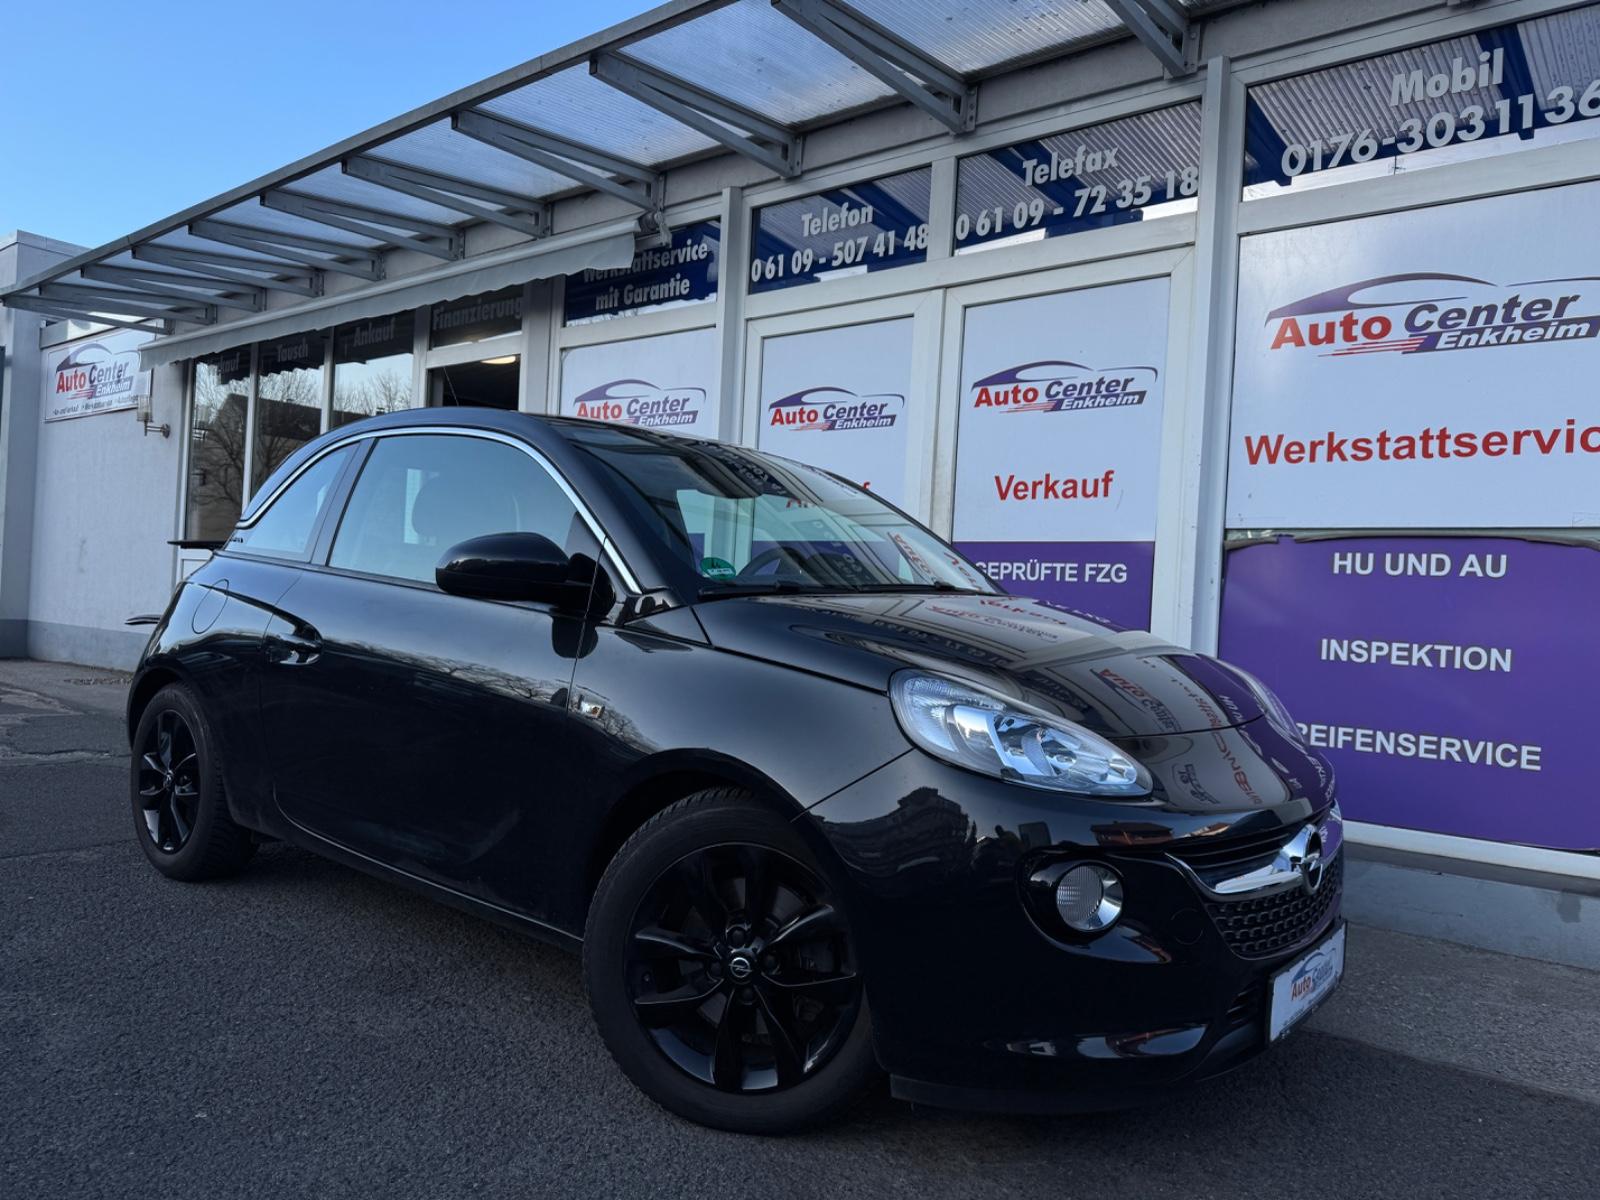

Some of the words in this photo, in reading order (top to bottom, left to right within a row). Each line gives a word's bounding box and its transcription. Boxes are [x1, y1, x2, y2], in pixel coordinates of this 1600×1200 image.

[1390, 48, 1504, 107] Mobil
[1023, 145, 1119, 187] Telefax
[1013, 199, 1044, 229] 09
[1073, 185, 1107, 217] 72
[1116, 175, 1151, 208] 35
[1164, 166, 1198, 199] 18
[801, 202, 874, 237] Telefon
[791, 248, 813, 274] 09
[832, 236, 868, 267] 507
[873, 230, 895, 257] 41
[904, 224, 929, 251] 48
[595, 286, 620, 311] mit
[624, 273, 690, 305] Garantie
[353, 317, 395, 347] Ankauf
[1270, 312, 1392, 350] Auto
[1404, 294, 1581, 334] Center
[1436, 321, 1591, 350] Enkheim
[56, 368, 87, 393] Auto
[89, 361, 129, 384] Center
[974, 385, 1039, 408] Auto
[1045, 377, 1135, 400] Center
[1061, 392, 1140, 410] Enkheim
[577, 400, 622, 420] Auto
[627, 396, 690, 416] Center
[639, 413, 693, 426] Enkheim
[771, 407, 818, 426] Auto
[823, 402, 888, 420] Center
[834, 417, 892, 430] Enkheim
[994, 470, 1115, 500] Verkauf
[1084, 563, 1128, 584] FZG
[1333, 552, 1374, 575] HU
[1385, 553, 1451, 576] UND
[1459, 554, 1508, 578] AU
[1321, 638, 1512, 673] INSPEKTION
[1292, 975, 1312, 1000] Auto
